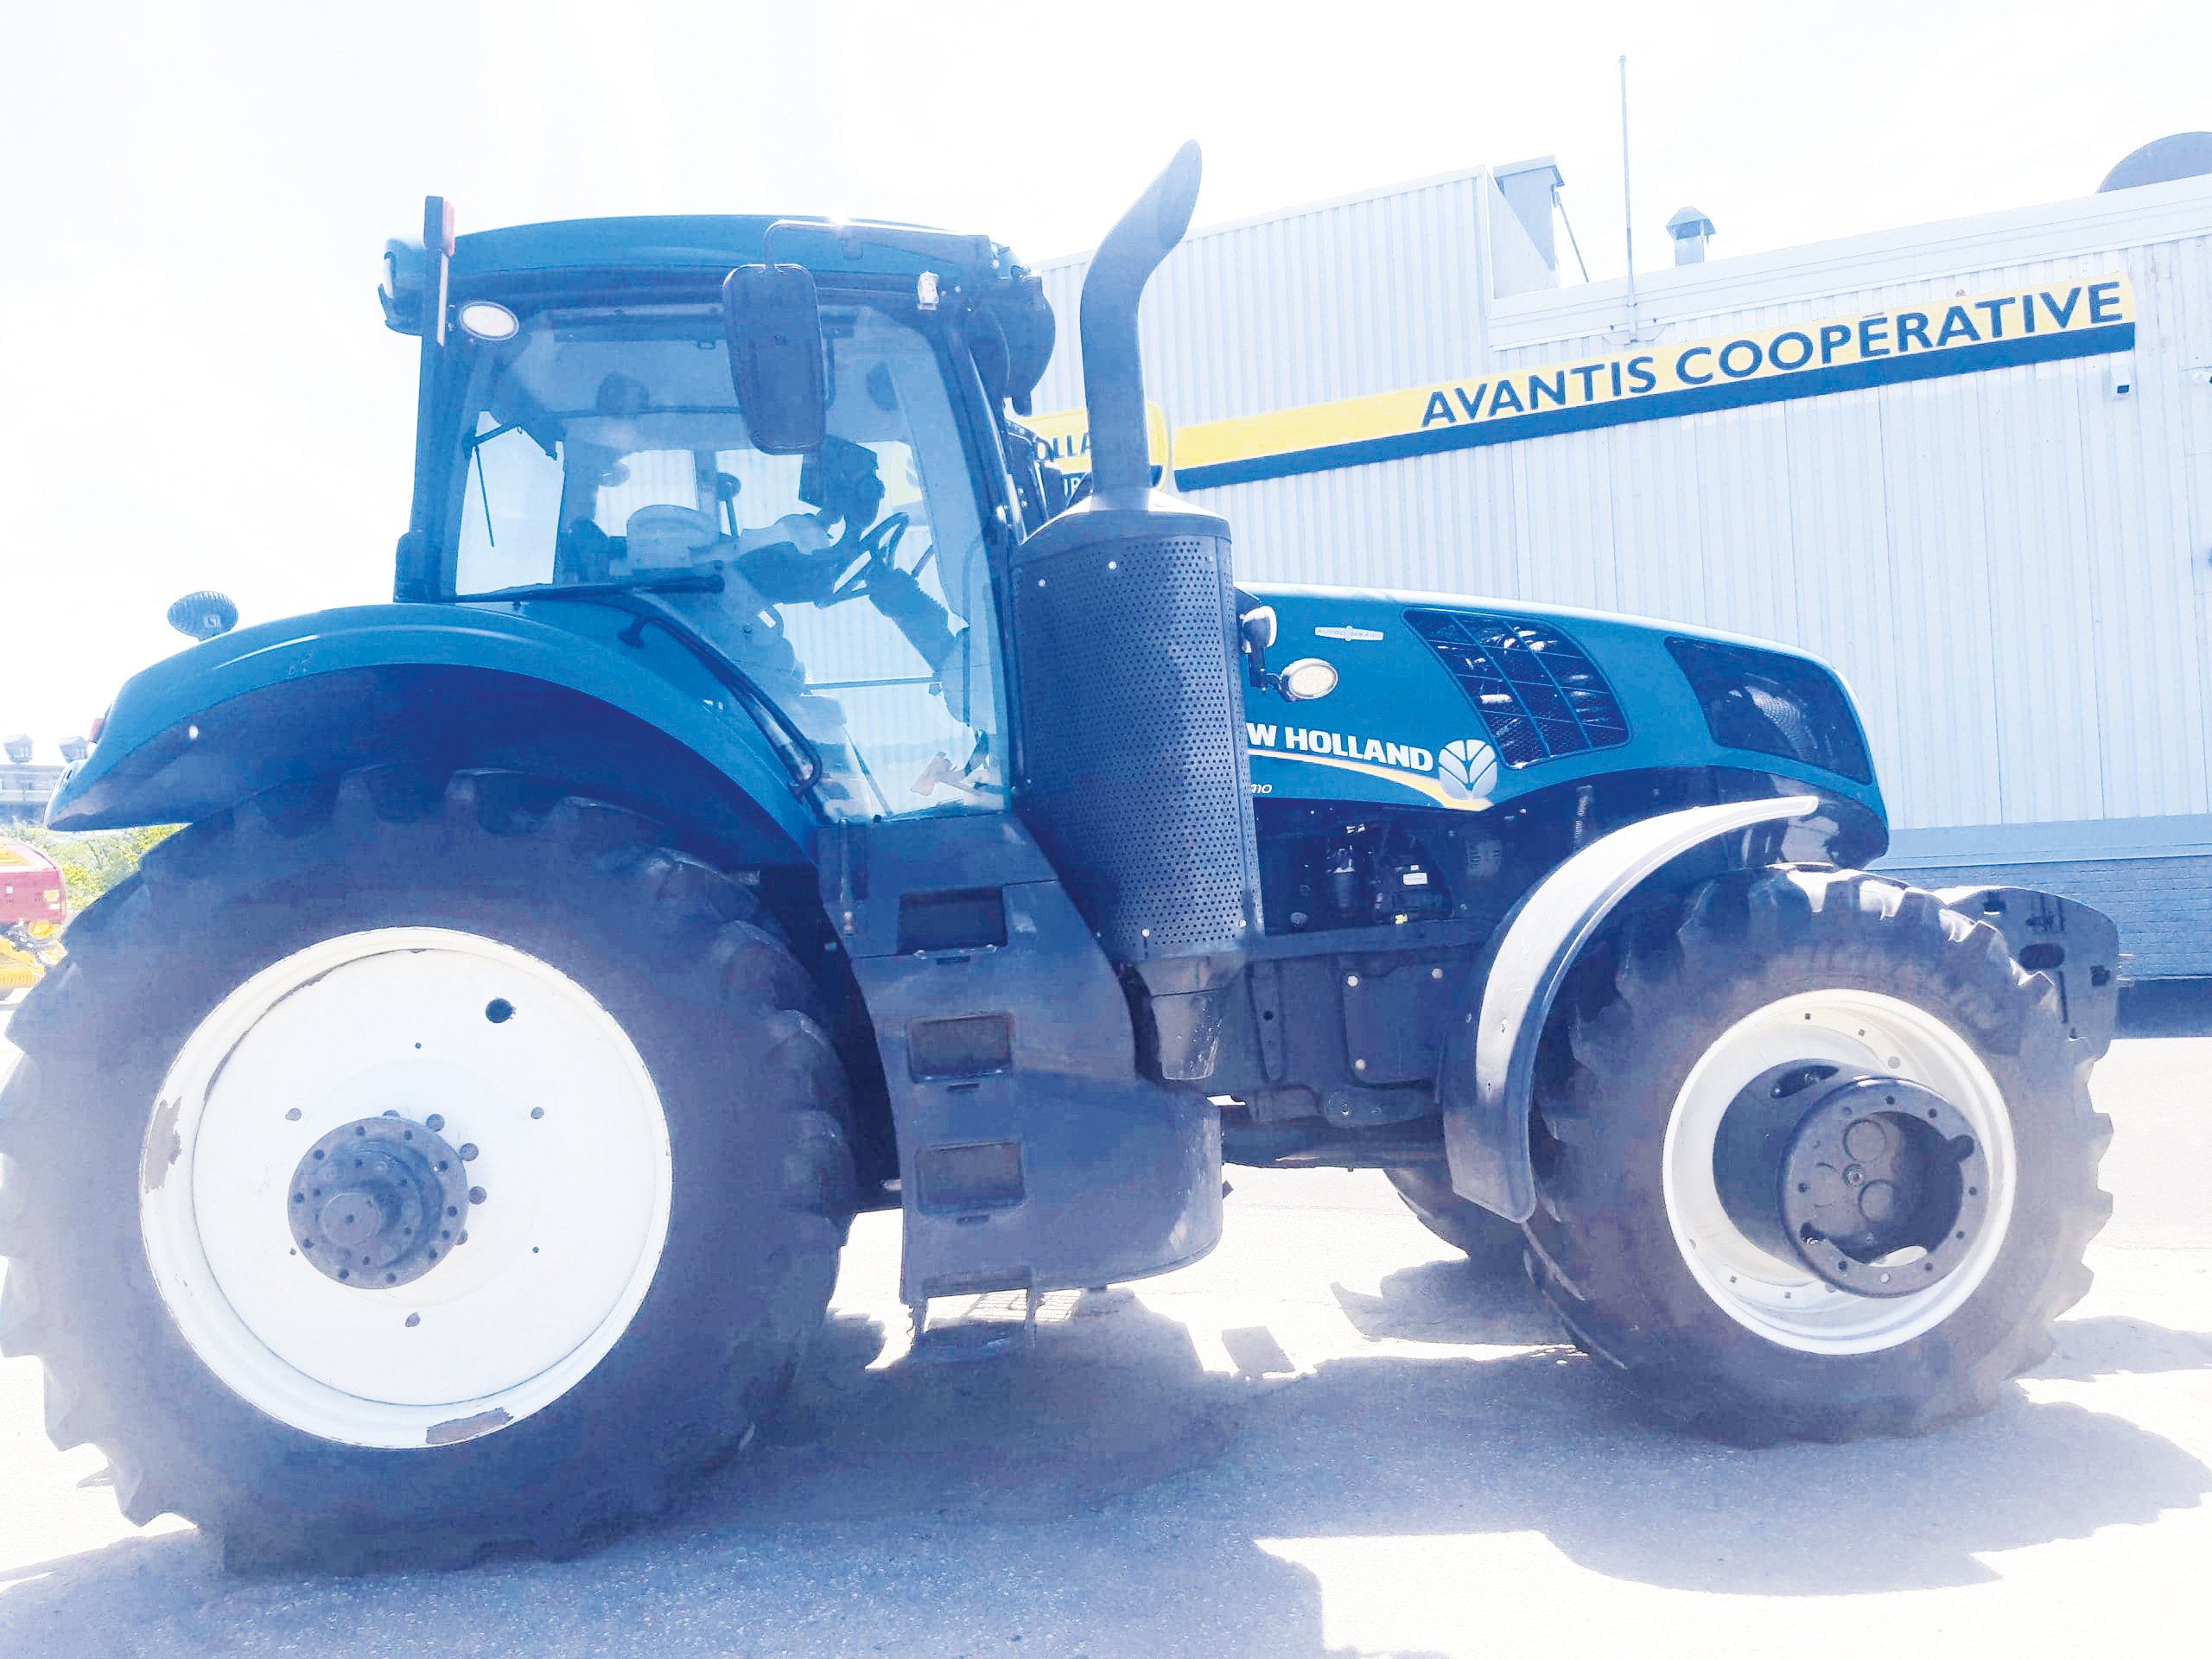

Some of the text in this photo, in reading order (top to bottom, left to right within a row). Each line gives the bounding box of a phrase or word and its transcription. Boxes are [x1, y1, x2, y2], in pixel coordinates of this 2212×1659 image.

[1421, 281, 2123, 428] AVANTIS COOPERATIVE
[1285, 727, 1433, 772] HOLLAND
